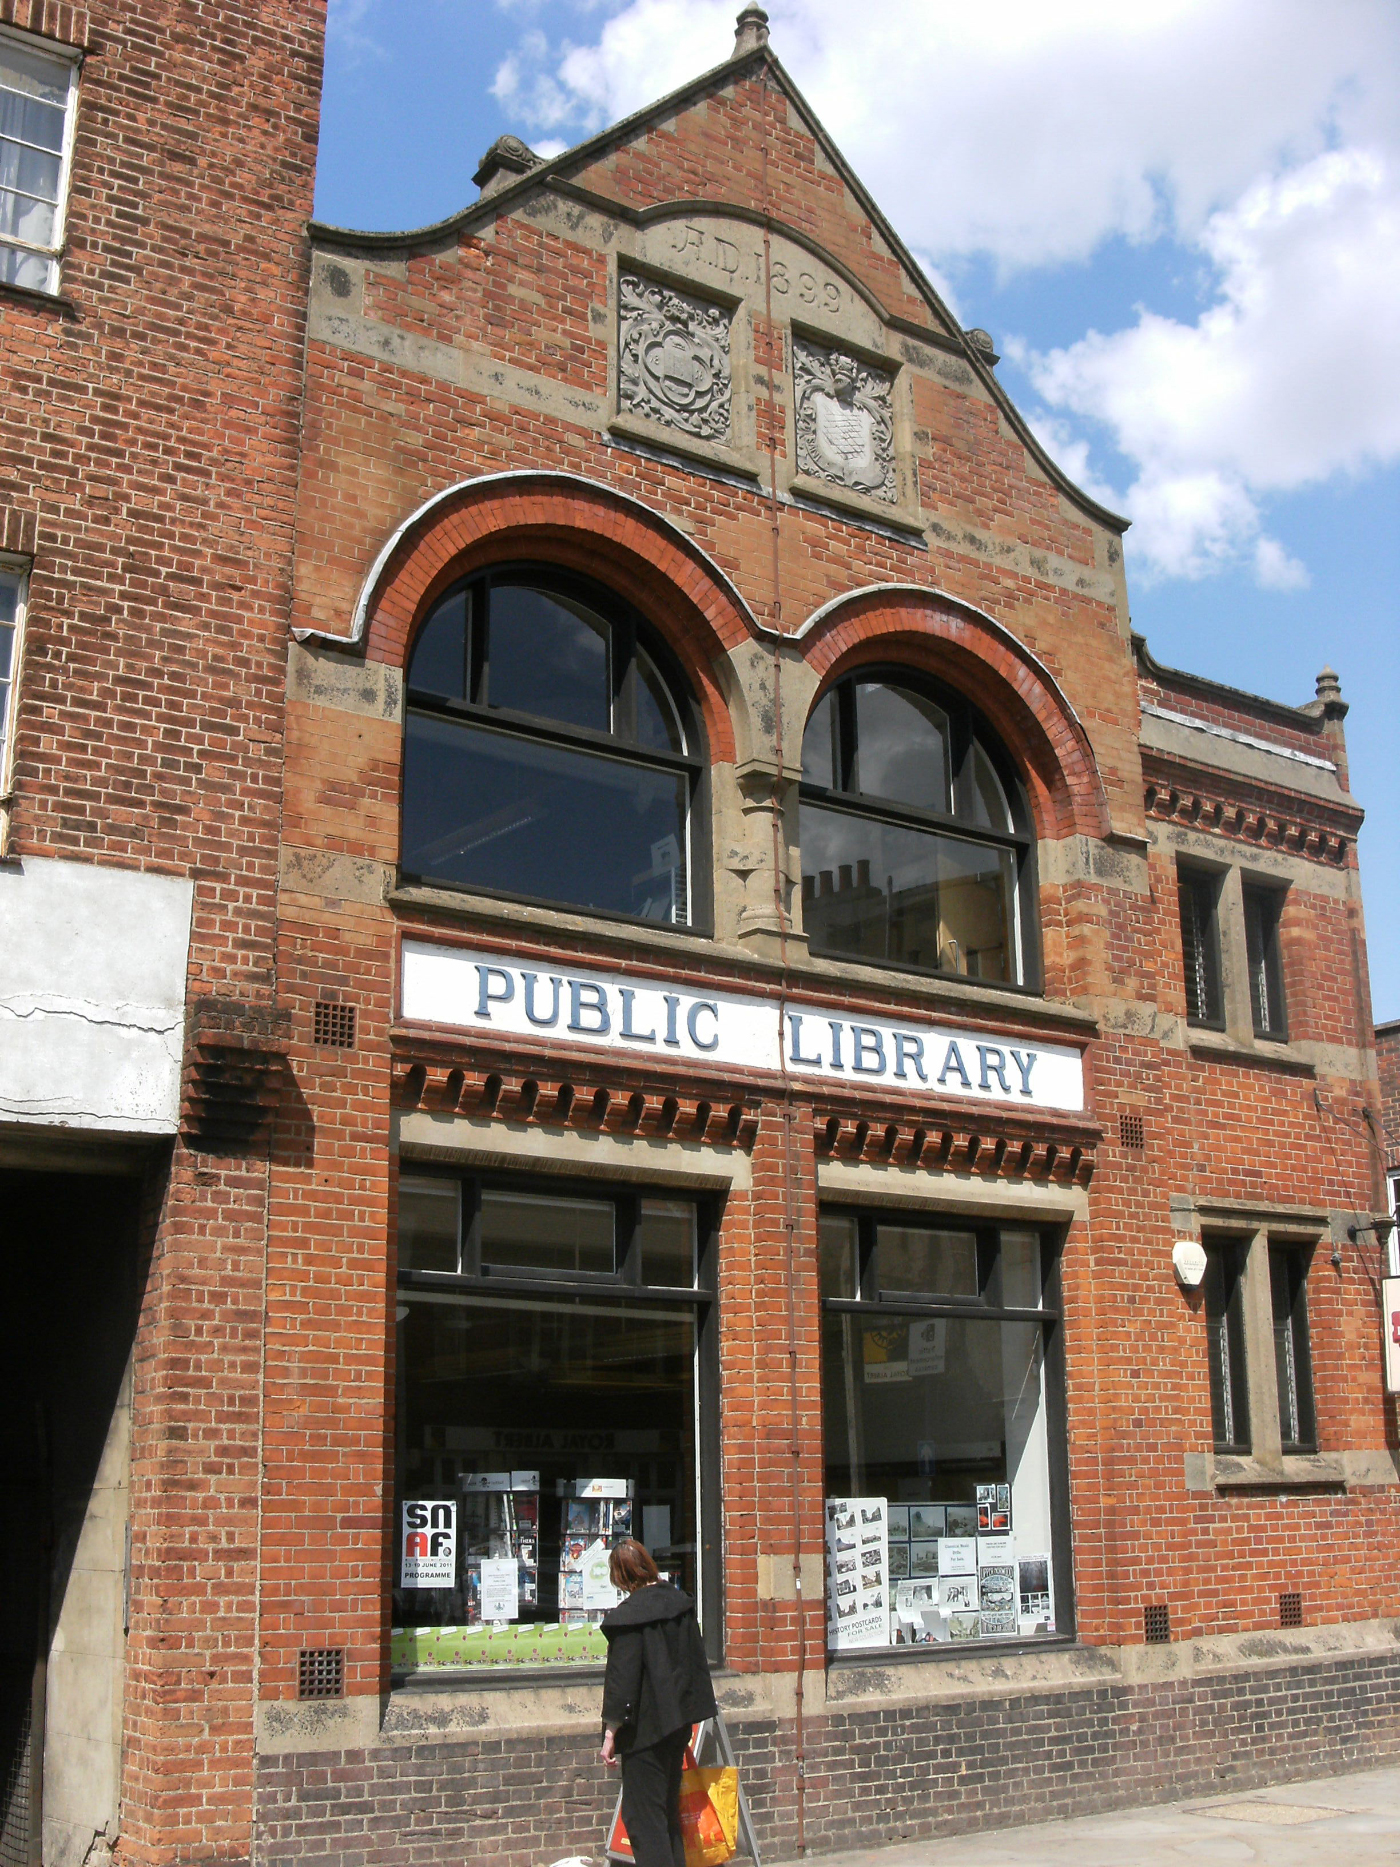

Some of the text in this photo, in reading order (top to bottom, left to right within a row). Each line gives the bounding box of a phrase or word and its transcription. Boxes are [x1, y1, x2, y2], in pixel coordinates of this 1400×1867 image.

[754, 252, 841, 313] 1899
[474, 965, 1038, 1095] PUBLIC LIBRARY
[404, 1571, 451, 1579] PROGRAMME
[829, 1615, 883, 1636] HISTORY POSTCARDS
[847, 1623, 883, 1637] FOR SALE
